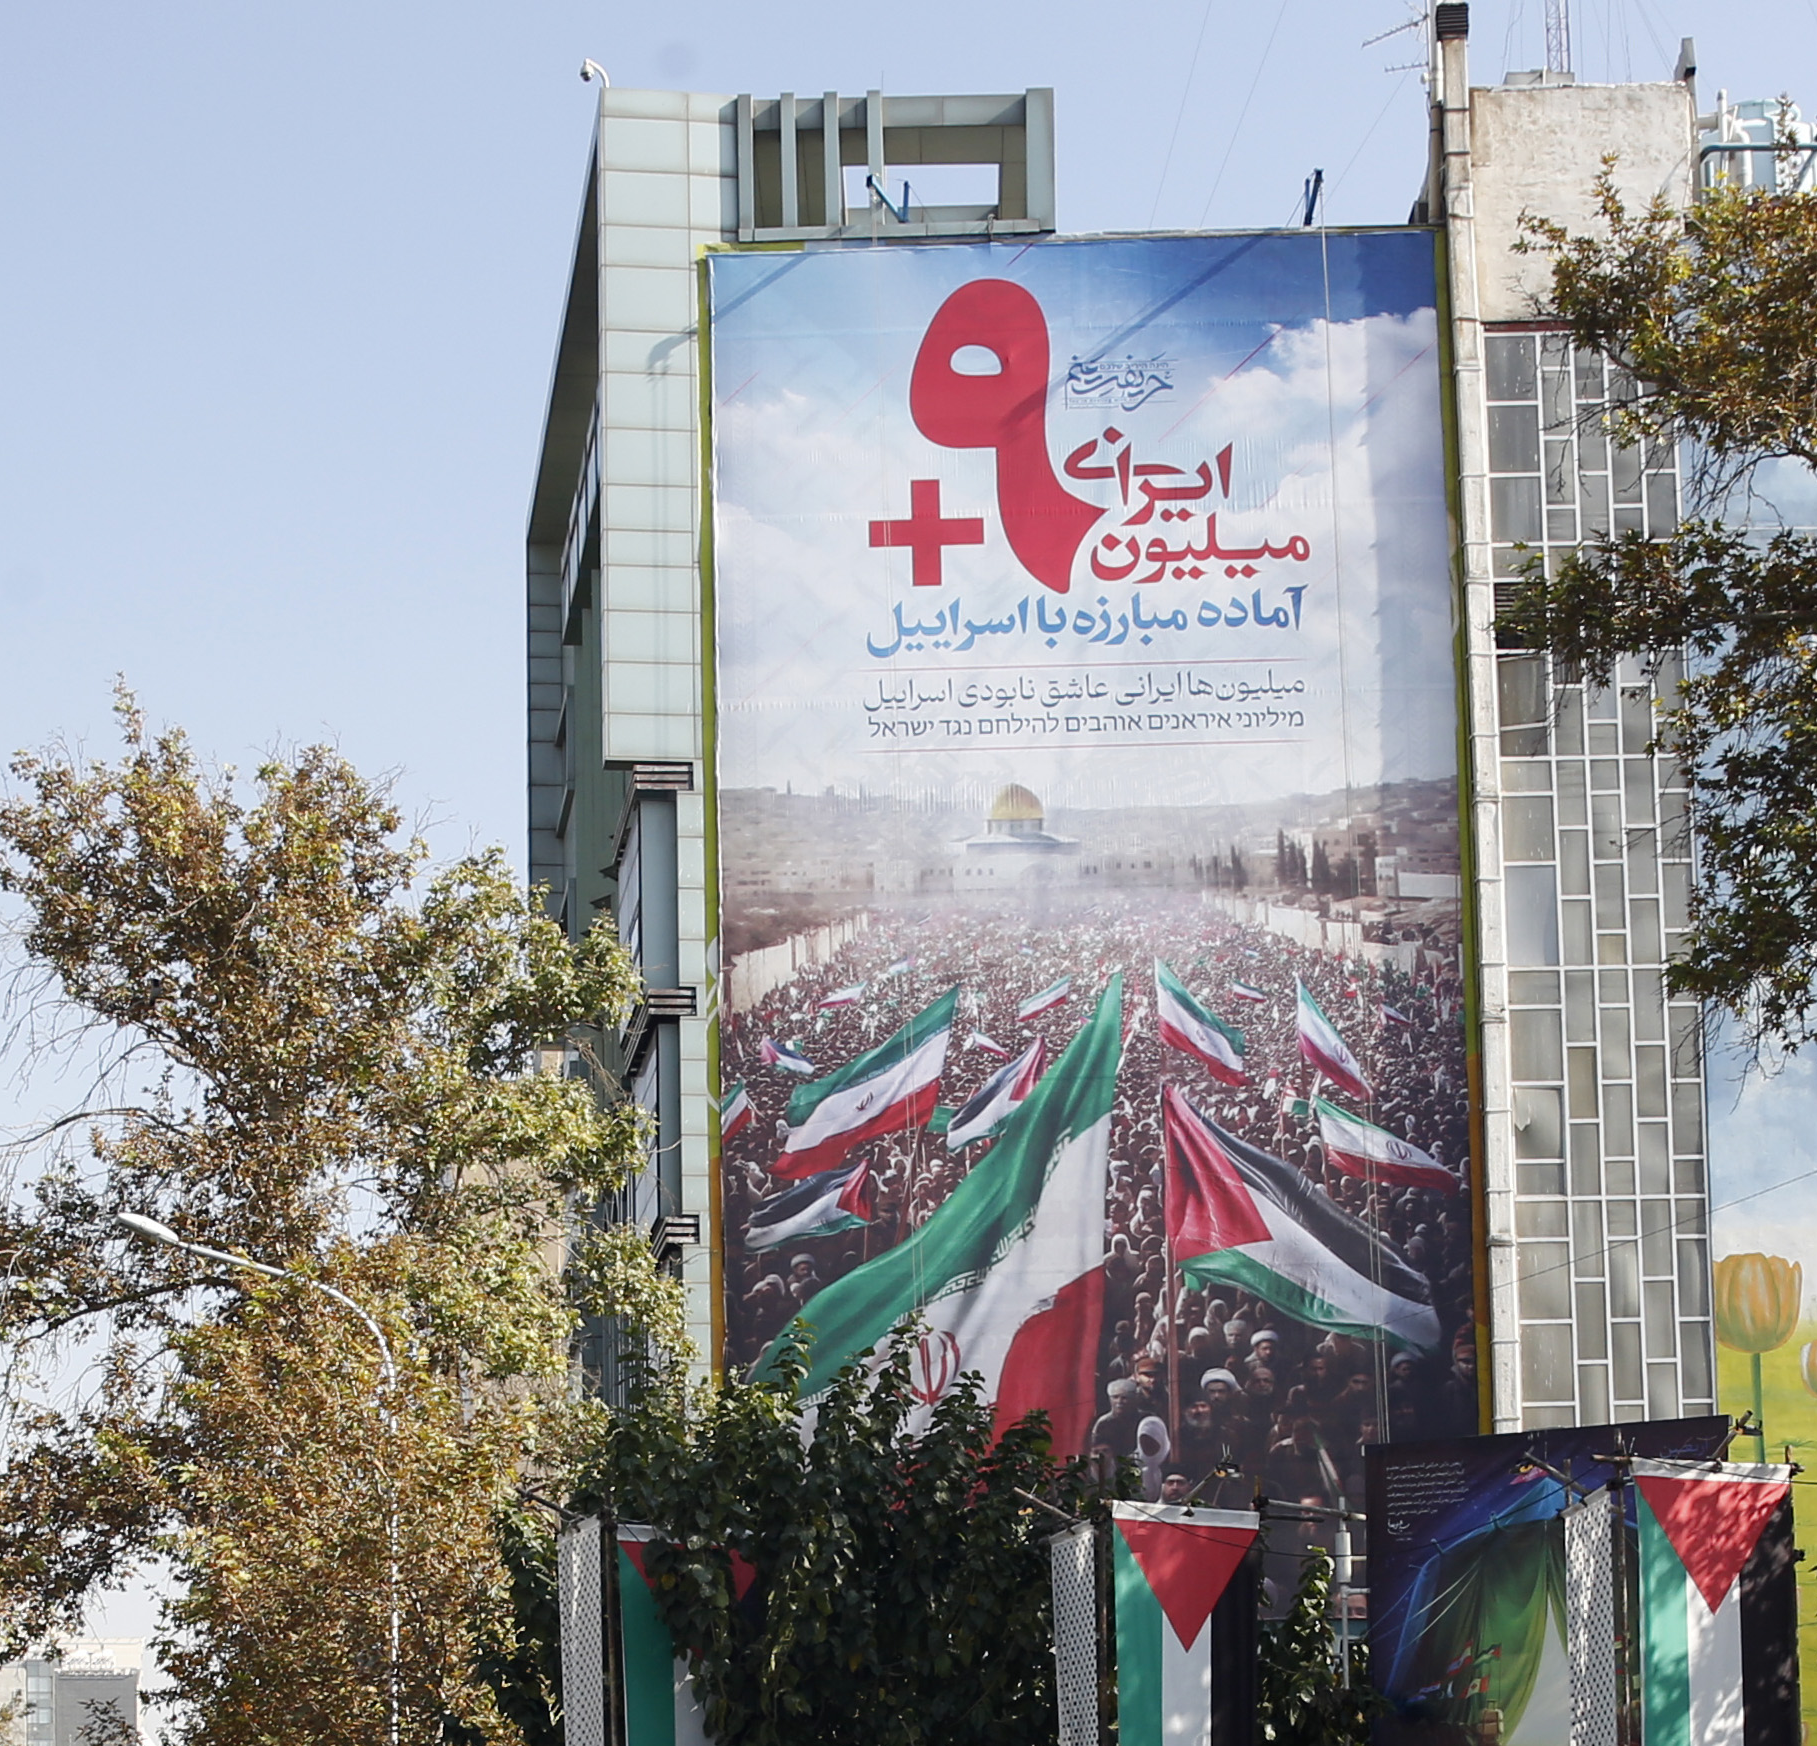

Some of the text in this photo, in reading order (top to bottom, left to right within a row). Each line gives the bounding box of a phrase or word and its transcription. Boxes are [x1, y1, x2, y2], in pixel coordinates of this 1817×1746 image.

[1063, 426, 1234, 526] ایرانی
[1090, 512, 1310, 584] میلیون
[866, 583, 1310, 658] آماده مبارزه با اسراییل
[863, 677, 953, 712] اسراییل
[958, 675, 1035, 709] نابودی
[1040, 673, 1109, 708] عاشق
[1115, 671, 1182, 706] ایرانی
[868, 706, 1305, 738] מיליוני איראנים אוהבים להילחם נגד ישראל
